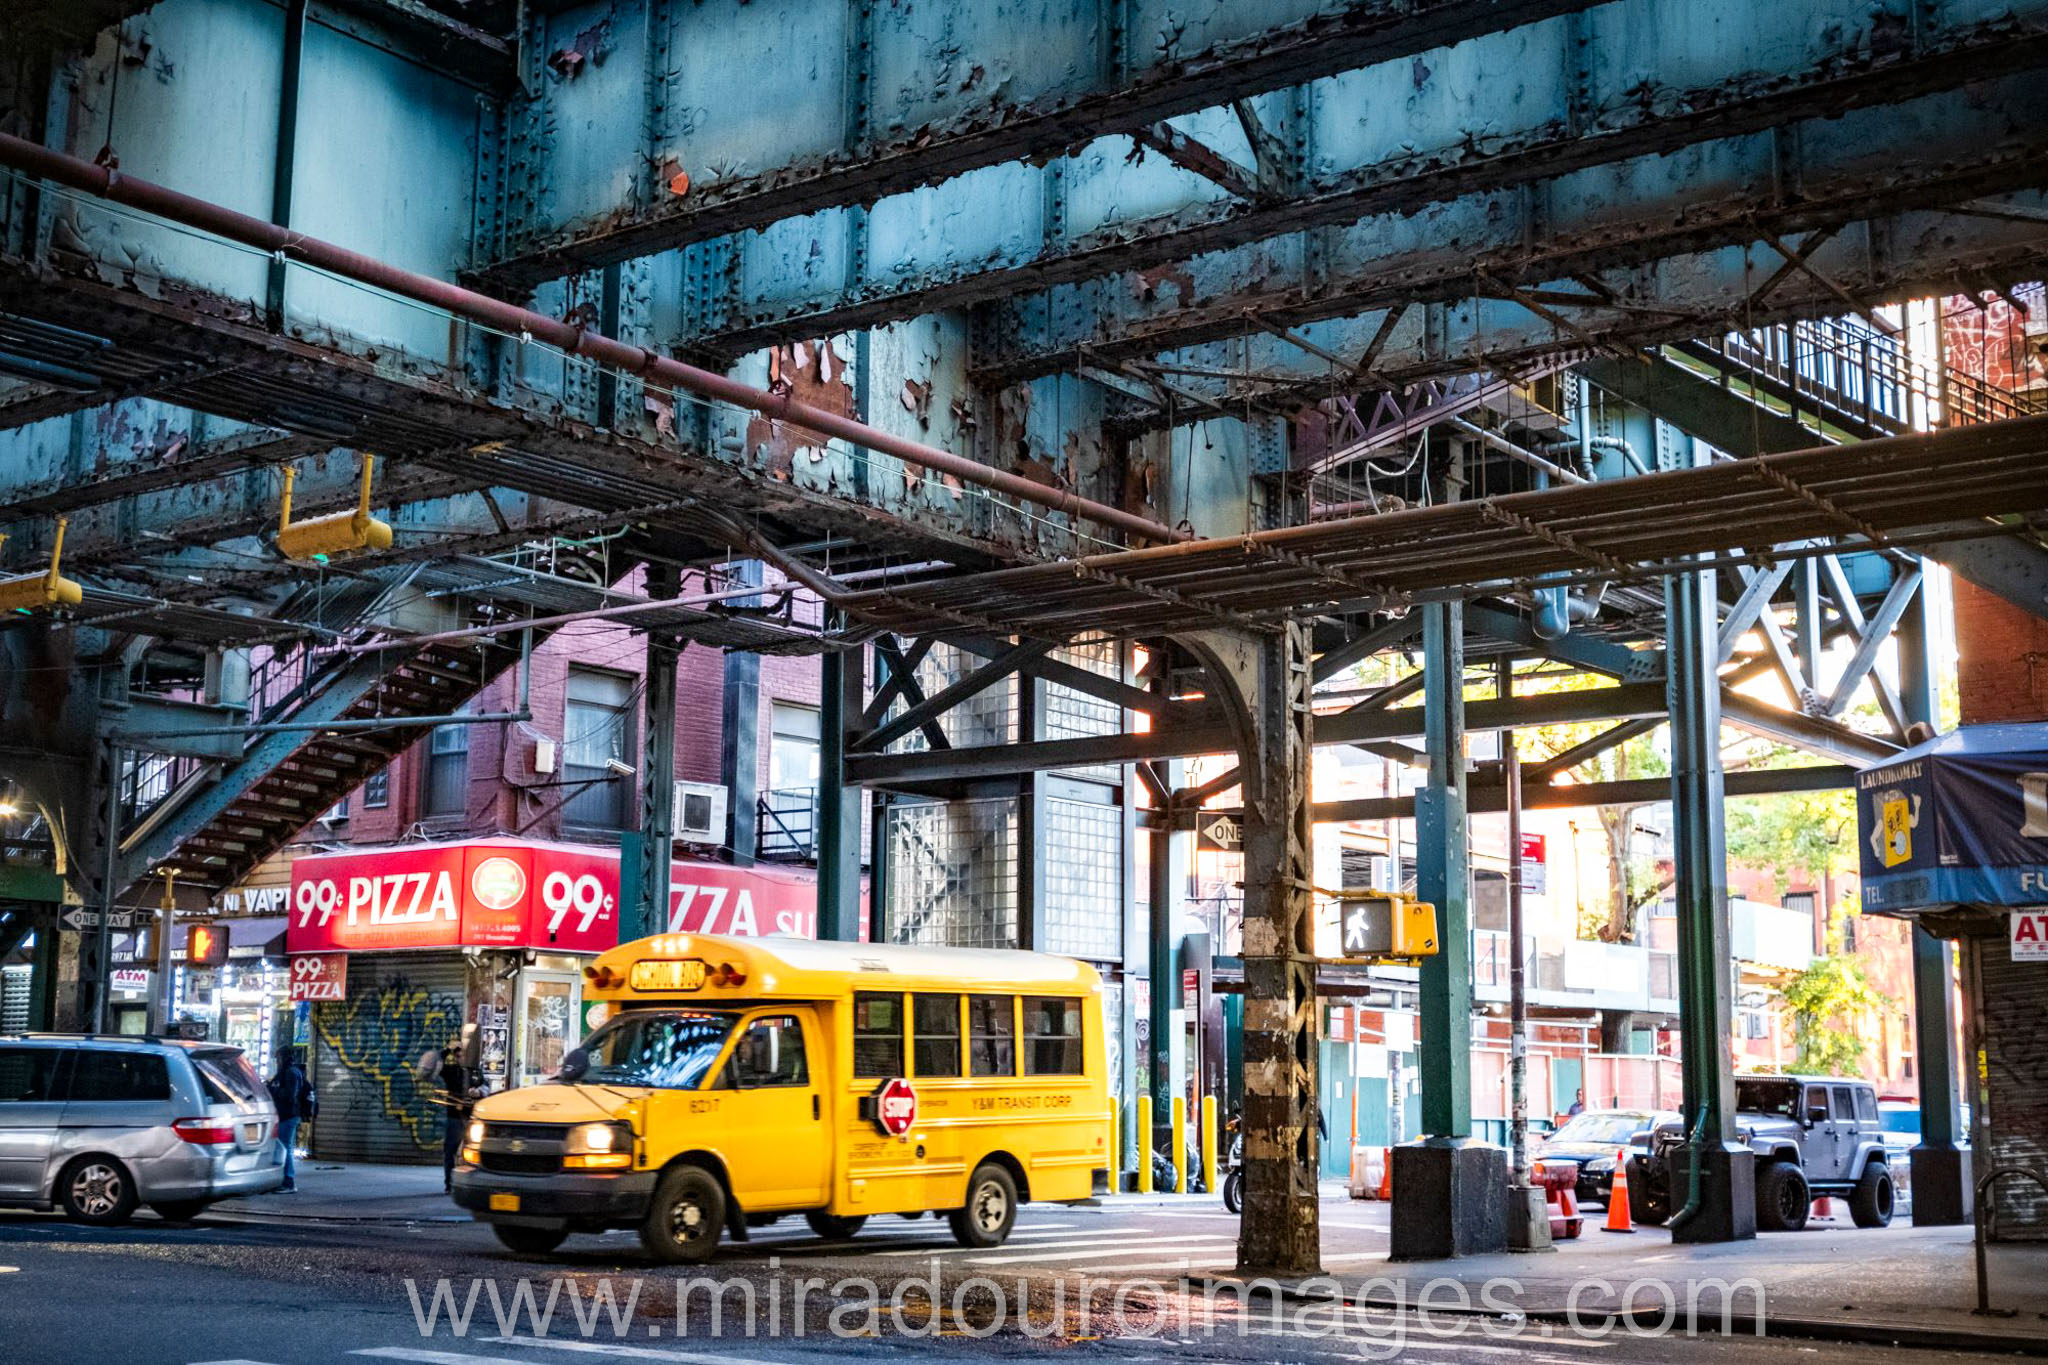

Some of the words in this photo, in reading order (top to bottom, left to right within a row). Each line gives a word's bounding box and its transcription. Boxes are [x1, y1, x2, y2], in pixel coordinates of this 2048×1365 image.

[1861, 761, 1923, 790] LAUNDROMAT
[1215, 824, 1244, 841] ONE
[347, 870, 457, 926] PIZZA
[1865, 885, 1885, 905] TEL.
[74, 913, 97, 925] ONE
[115, 969, 147, 982] ATM
[292, 981, 342, 999] PIZZA
[885, 1096, 914, 1118] STOP
[998, 1096, 1041, 1109] TRANSIT
